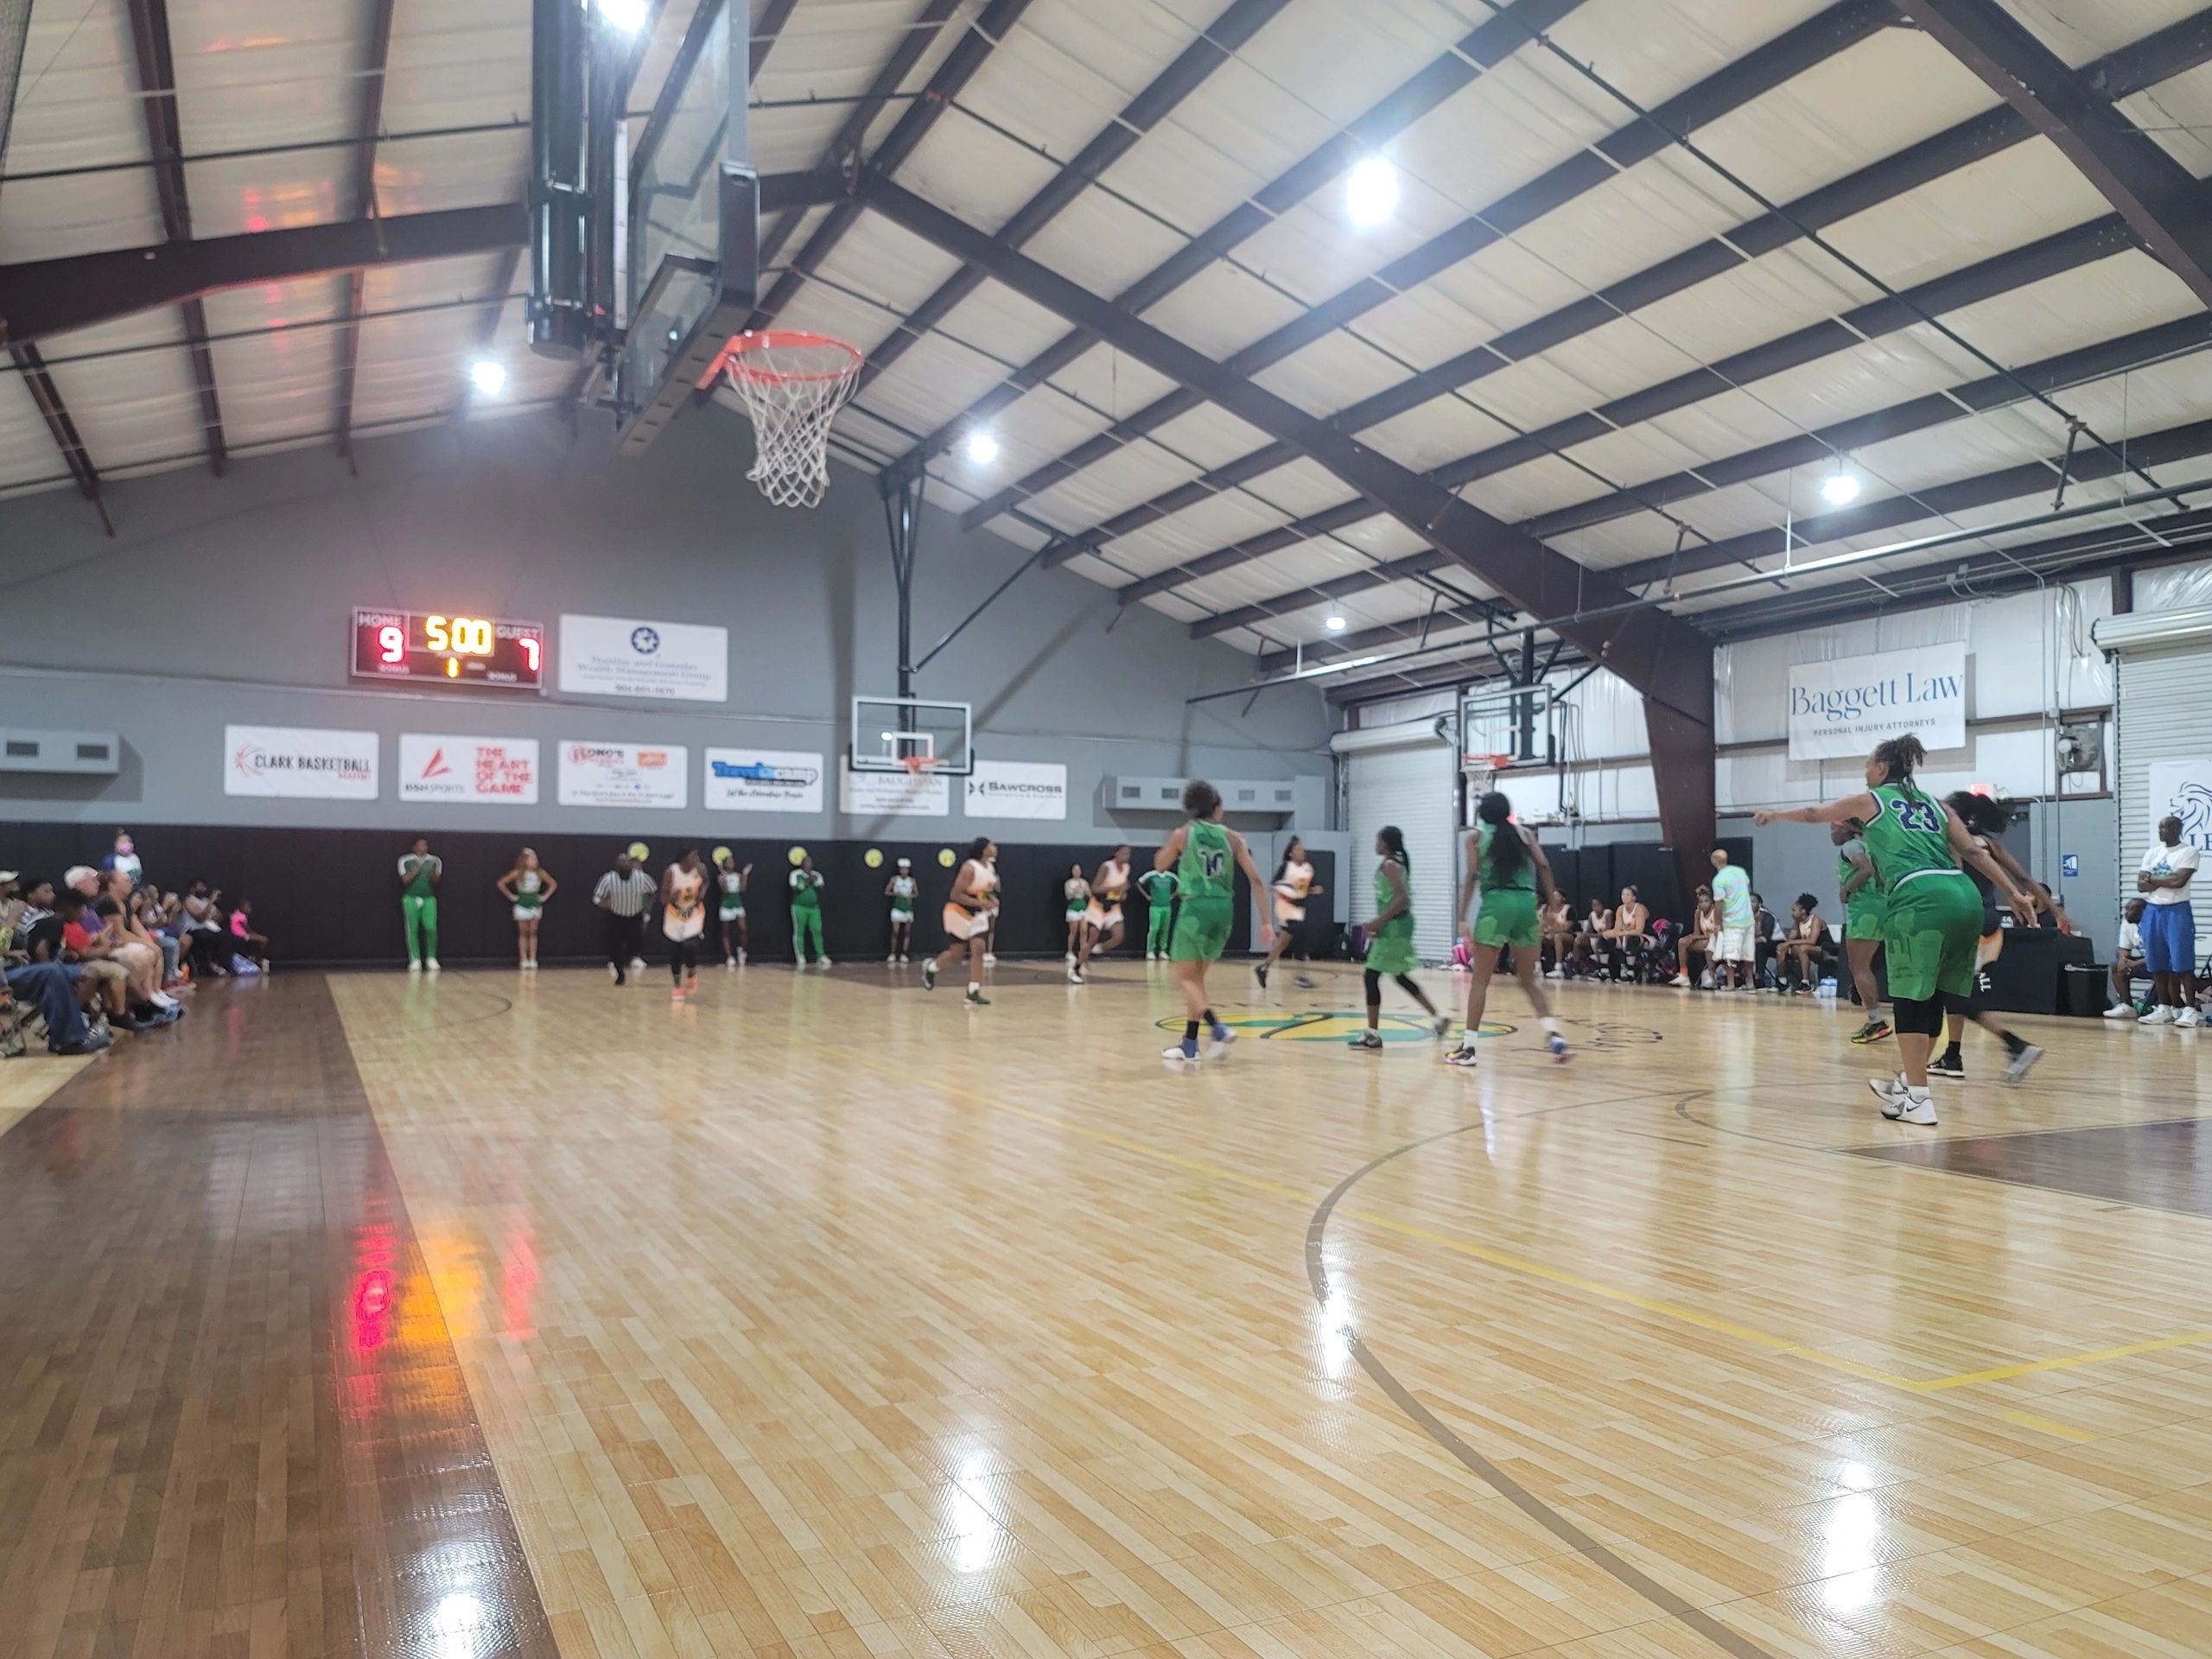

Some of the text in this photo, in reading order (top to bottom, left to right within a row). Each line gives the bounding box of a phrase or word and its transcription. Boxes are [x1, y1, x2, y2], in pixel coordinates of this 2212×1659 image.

[359, 613, 402, 626] HOME
[496, 626, 540, 639] GUEST
[379, 626, 404, 663] 9
[518, 638, 540, 671] 7
[1792, 672, 1963, 721] Baggett Law
[1855, 723, 1884, 733] INJURY
[1886, 718, 1936, 730] ATTORNEYS
[476, 747, 503, 757] THE
[255, 754, 371, 772] CLARK BASKETBALL
[476, 760, 530, 770] HEART
[476, 772, 531, 782] OF THE
[405, 784, 465, 793] BSN SPORTS
[476, 784, 522, 794] GAME
[1890, 798, 1941, 833] 23
